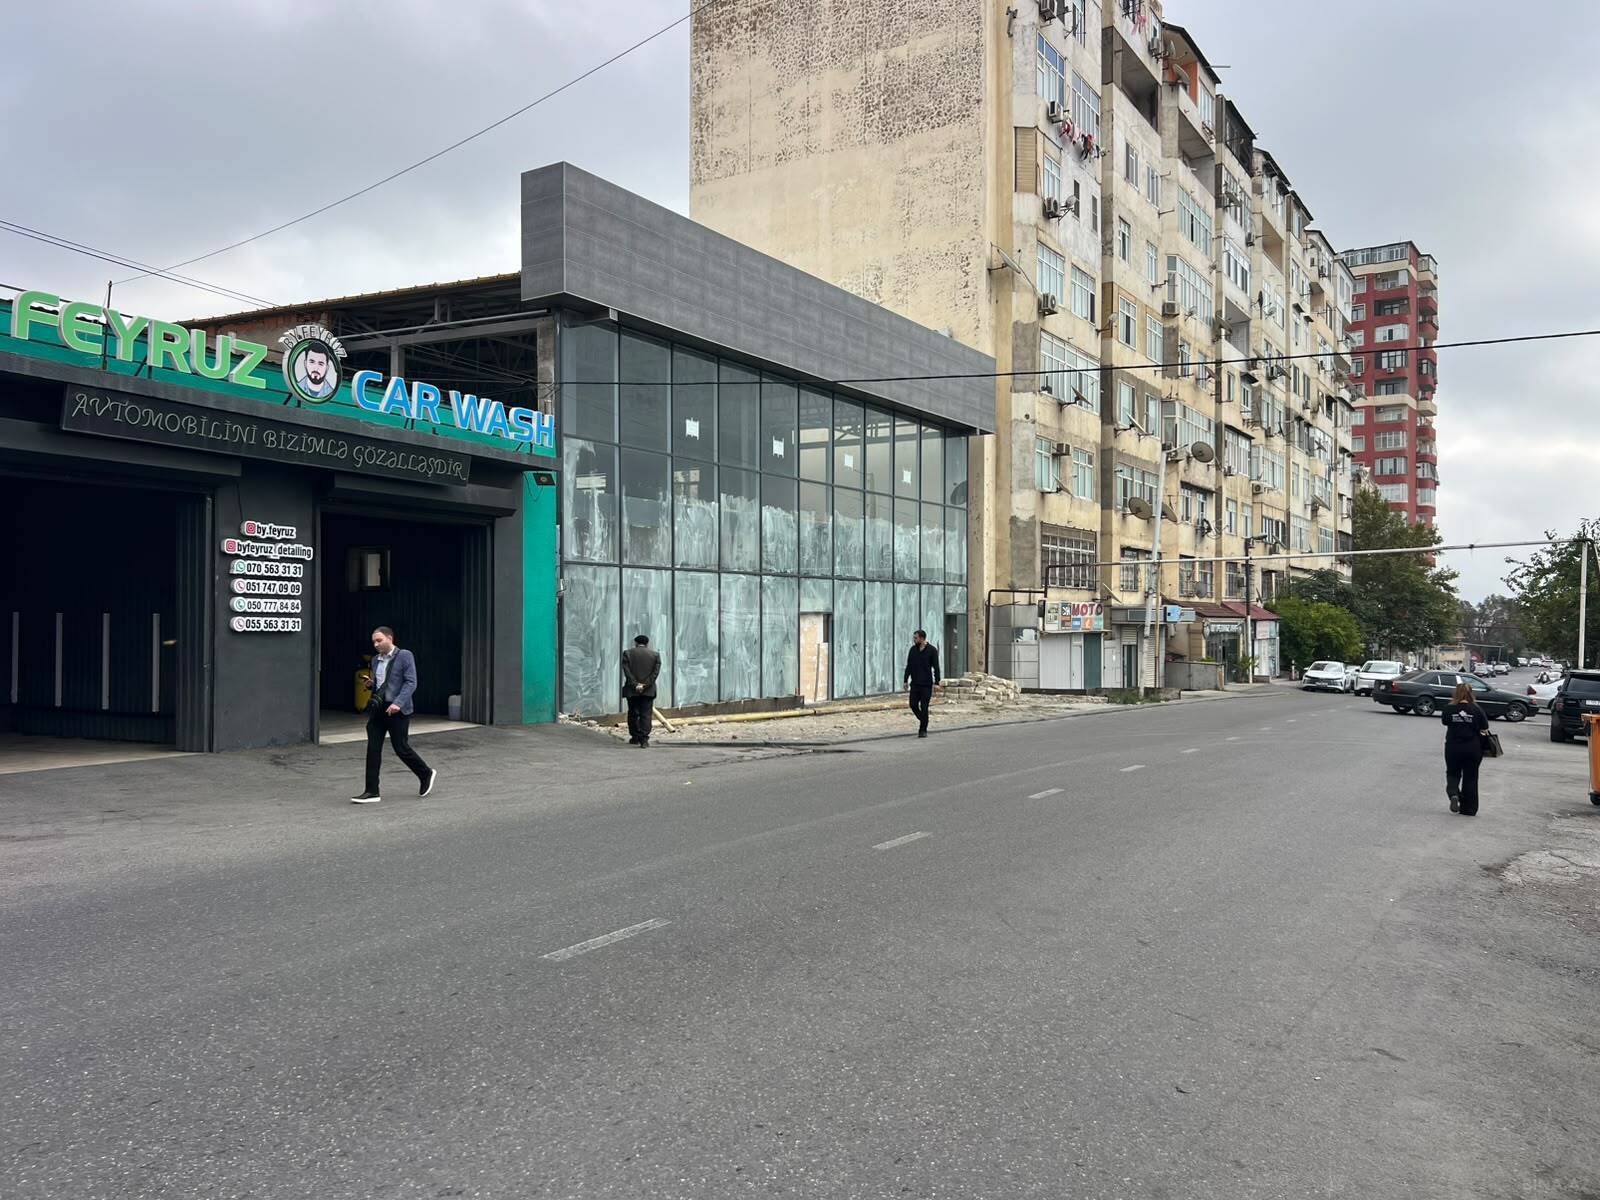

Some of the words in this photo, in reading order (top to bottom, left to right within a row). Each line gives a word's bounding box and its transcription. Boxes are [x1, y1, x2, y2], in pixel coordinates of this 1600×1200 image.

[11, 290, 268, 389] FEYRUZ
[351, 370, 441, 425] CAR
[448, 389, 555, 448] WASH
[256, 523, 295, 538] by.feyruz
[237, 542, 312, 559] byfeyruz_detailing
[246, 562, 262, 573] 070
[264, 563, 279, 574] 563
[281, 564, 291, 575] 31
[293, 565, 302, 576] 31
[245, 581, 261, 592] 051
[262, 582, 276, 593] 747
[278, 583, 289, 593] 09
[290, 584, 301, 594] 09
[247, 600, 261, 610] 050
[263, 600, 277, 610] 777
[279, 601, 289, 611] 84
[290, 601, 300, 611] 84
[1071, 603, 1104, 617] MOTO
[245, 618, 261, 629] 055
[263, 619, 278, 629] 563
[280, 619, 290, 630] 31
[291, 620, 301, 630] 31
